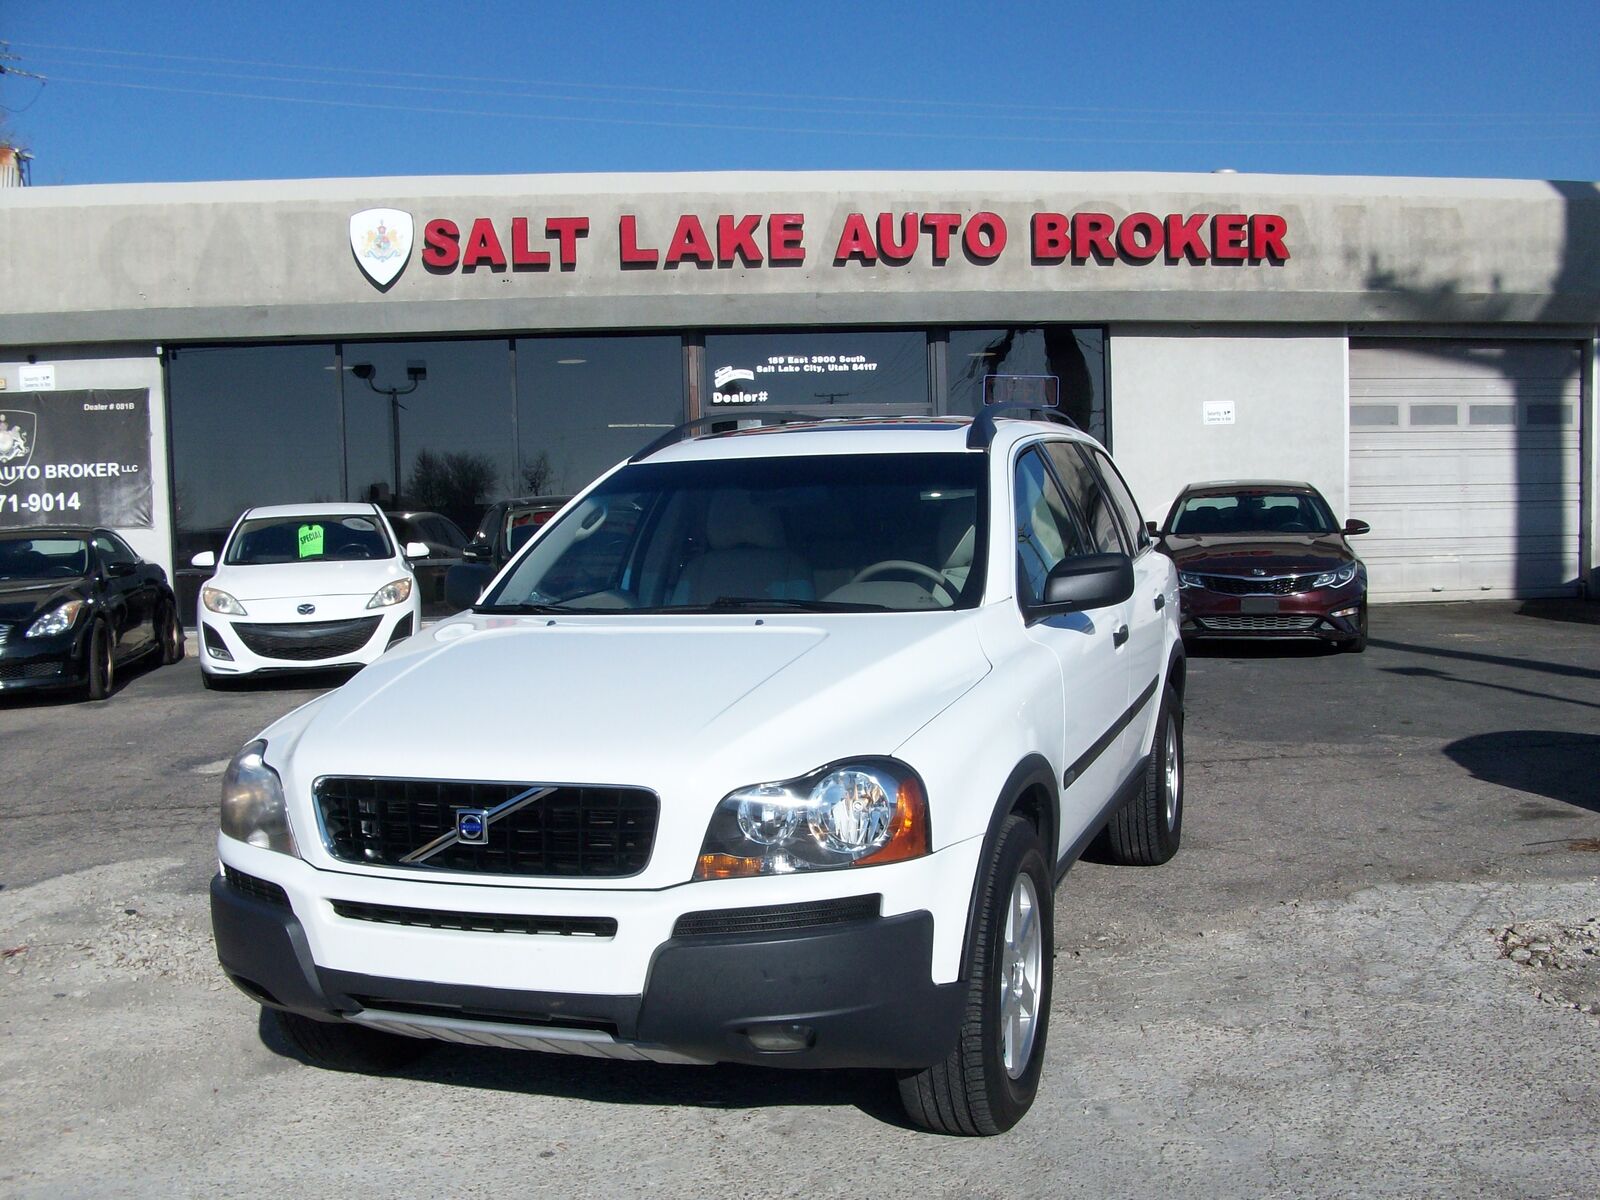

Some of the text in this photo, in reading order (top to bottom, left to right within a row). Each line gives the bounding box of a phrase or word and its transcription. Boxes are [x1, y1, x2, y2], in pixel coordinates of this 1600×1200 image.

[421, 217, 589, 274] SALT
[619, 214, 806, 270] LAKE
[832, 212, 1008, 267] AUTO
[1030, 212, 1291, 266] BROKER
[787, 355, 809, 364] East
[811, 355, 836, 364] 3900
[839, 354, 866, 364] South
[756, 363, 878, 374] Salt Lake City, Utah 84117
[712, 390, 769, 404] Dealer#
[83, 403, 109, 411] Dealer
[109, 403, 115, 411] #
[44, 462, 121, 480] BROKER
[121, 464, 139, 474] LLC
[300, 531, 322, 545] SPECIAL
